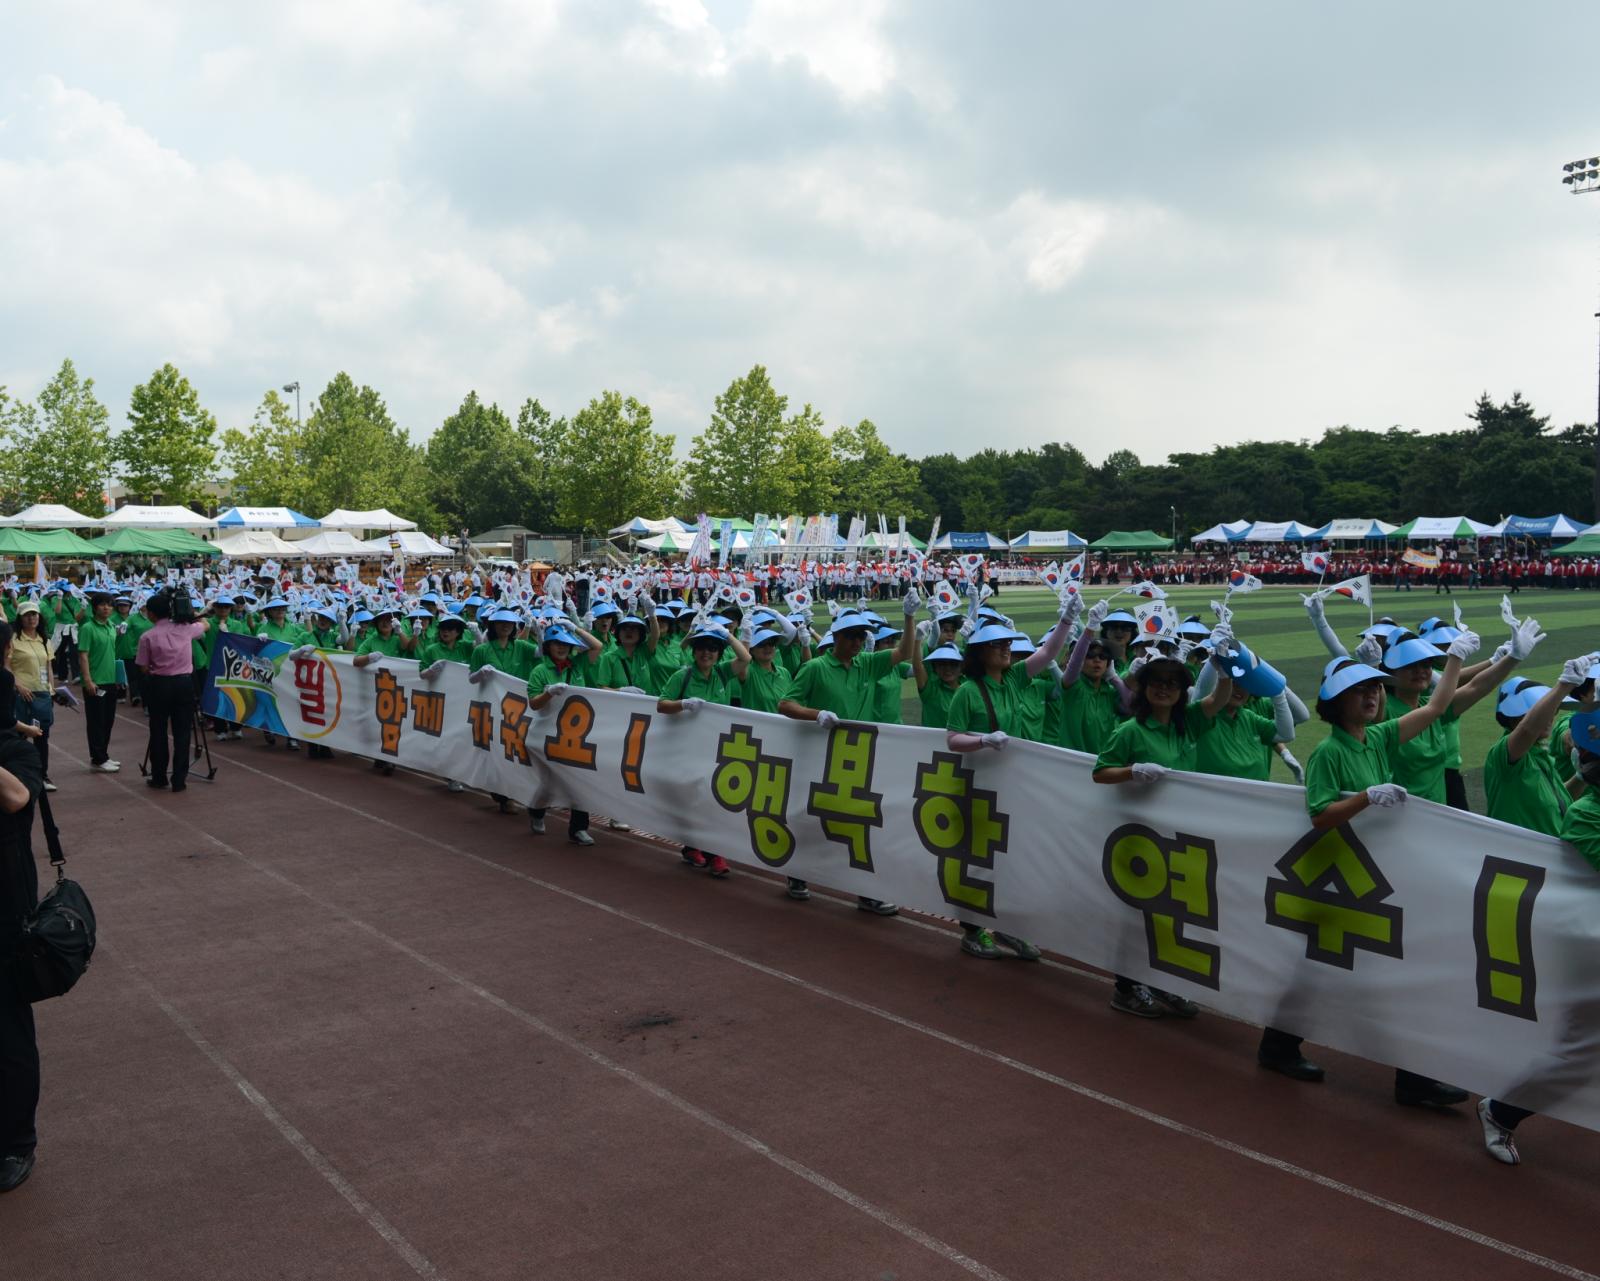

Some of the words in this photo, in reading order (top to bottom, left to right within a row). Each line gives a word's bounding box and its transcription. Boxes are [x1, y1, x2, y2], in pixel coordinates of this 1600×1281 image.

[223, 646, 275, 686] Yeonsu
[375, 667, 446, 757] 함께
[711, 722, 1010, 918] 행복한
